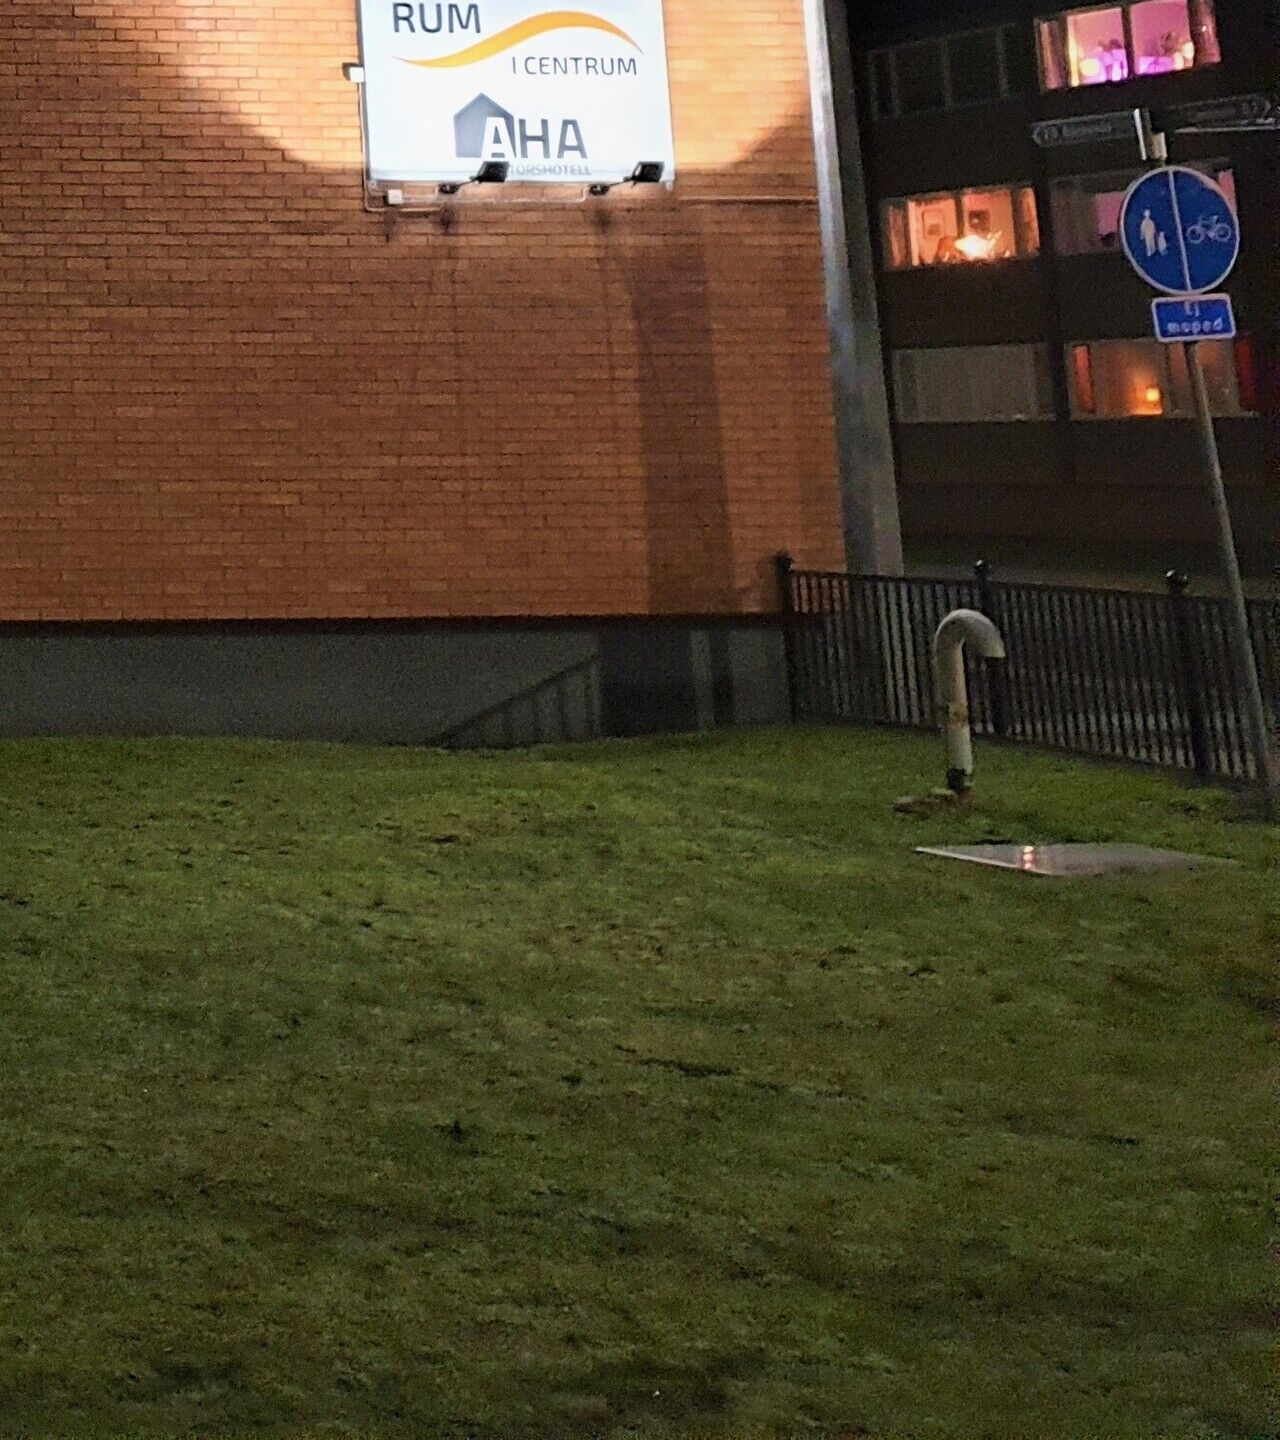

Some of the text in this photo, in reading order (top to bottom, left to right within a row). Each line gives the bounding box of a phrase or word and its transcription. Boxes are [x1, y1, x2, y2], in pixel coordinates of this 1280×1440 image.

[392, 2, 481, 33] RUM
[524, 55, 637, 75] CENTRUM
[480, 117, 588, 159] AHA
